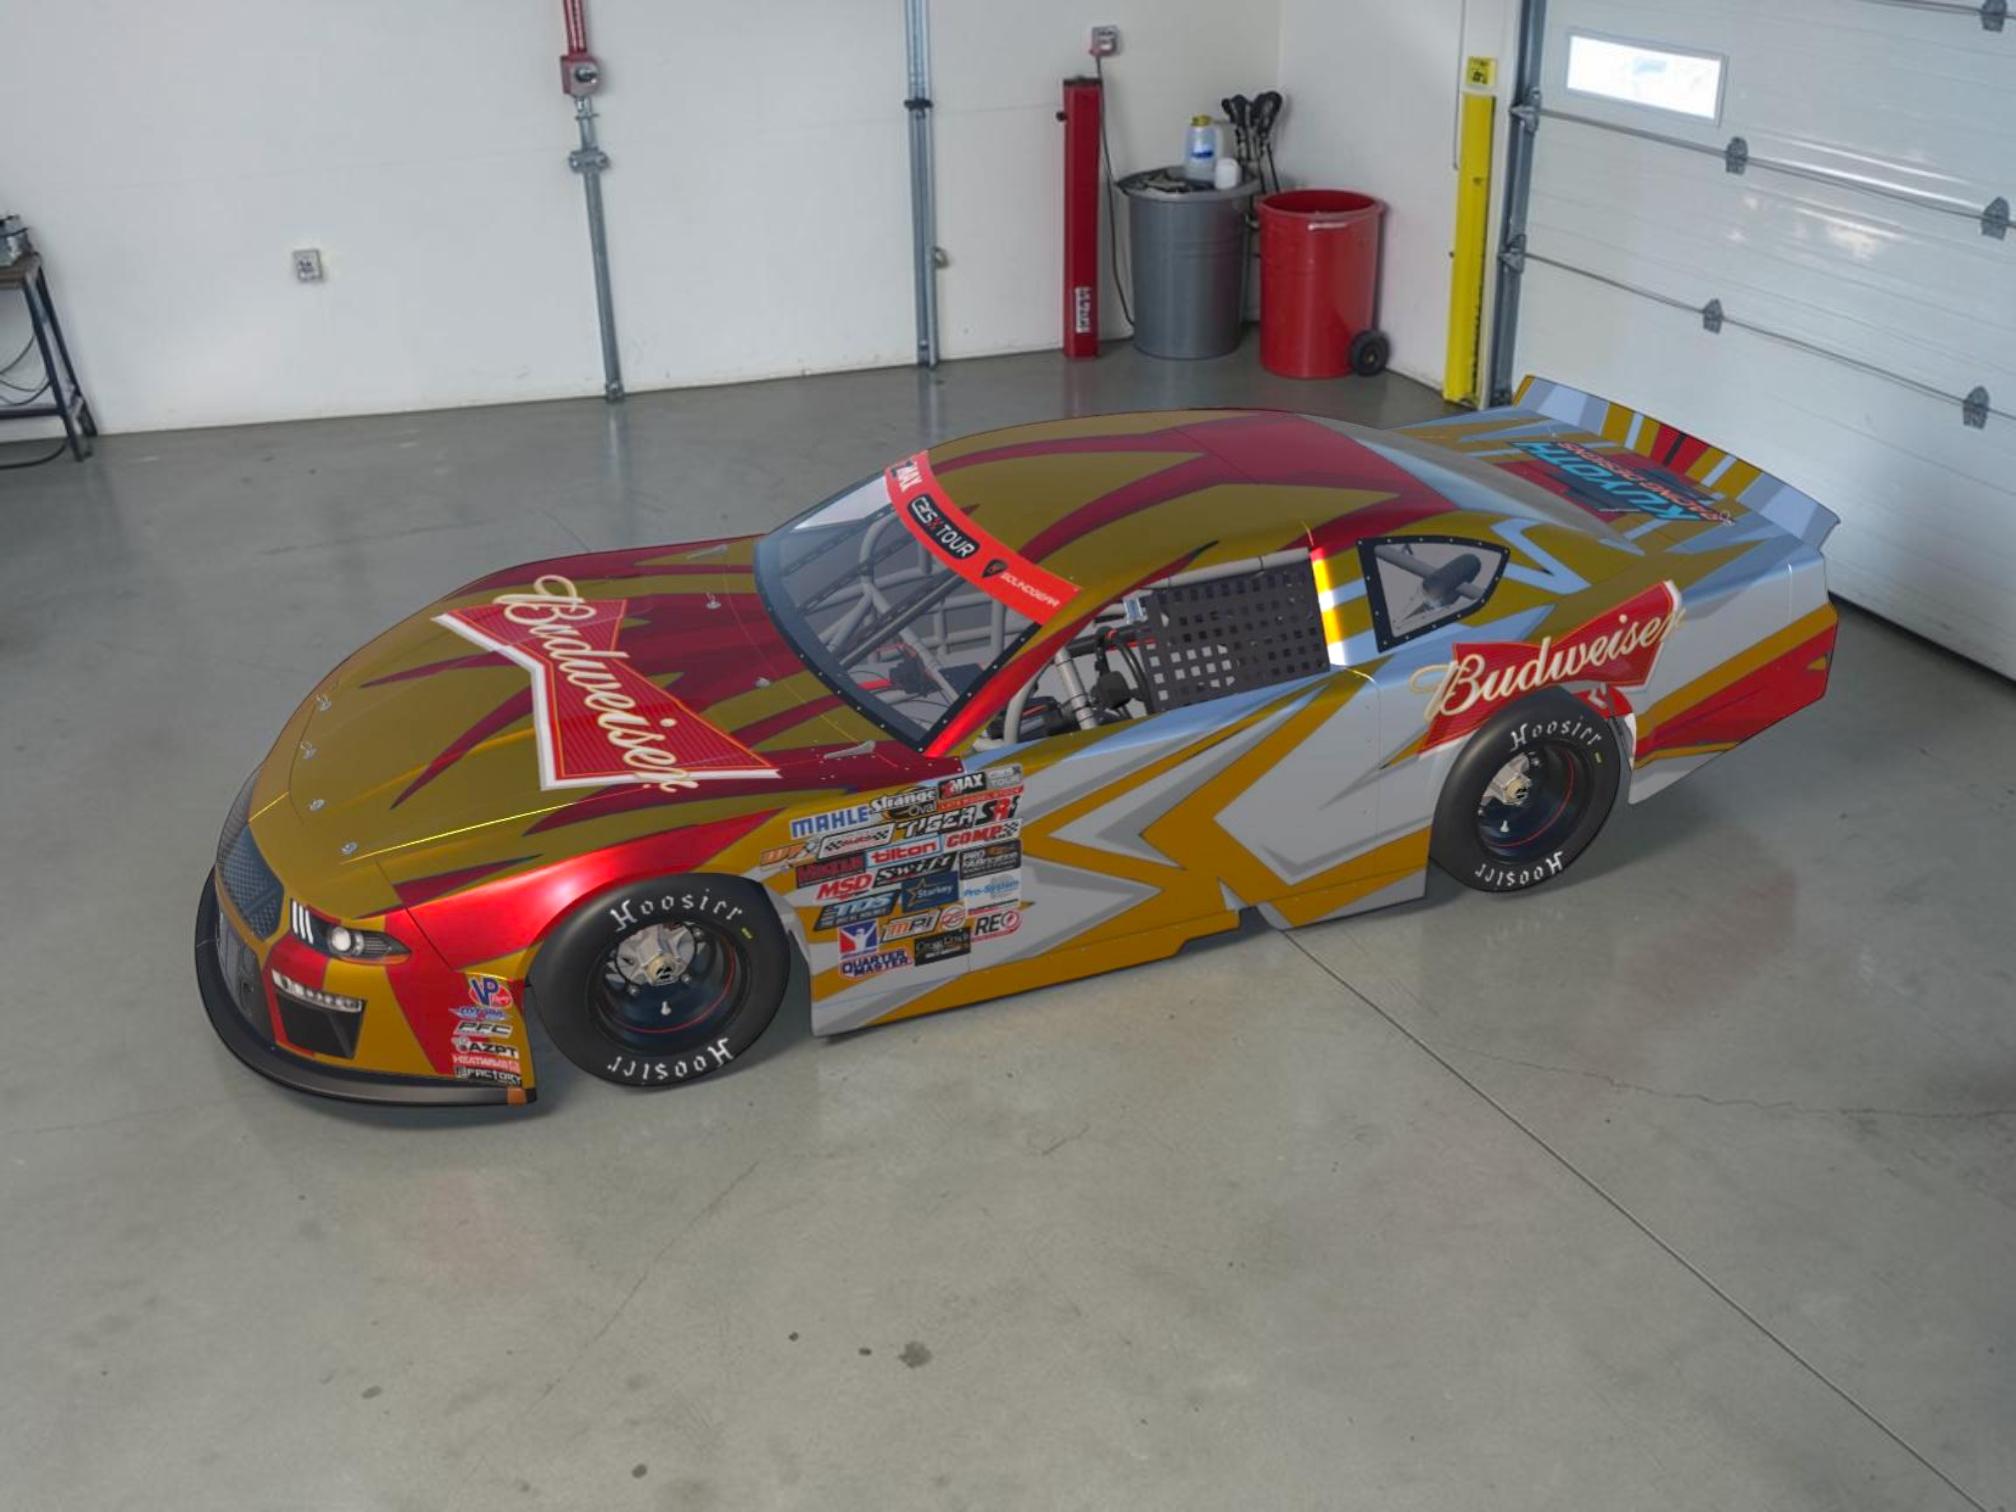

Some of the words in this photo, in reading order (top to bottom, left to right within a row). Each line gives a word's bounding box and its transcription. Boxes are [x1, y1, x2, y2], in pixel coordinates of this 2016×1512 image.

[935, 523, 976, 558] TOUR
[1408, 607, 1686, 724] Budweiser
[493, 575, 699, 793] Budweiser
[791, 806, 870, 838] MAHLE
[817, 873, 873, 900] MSD
[470, 977, 499, 1006] VP
[458, 1022, 511, 1035] PFC
